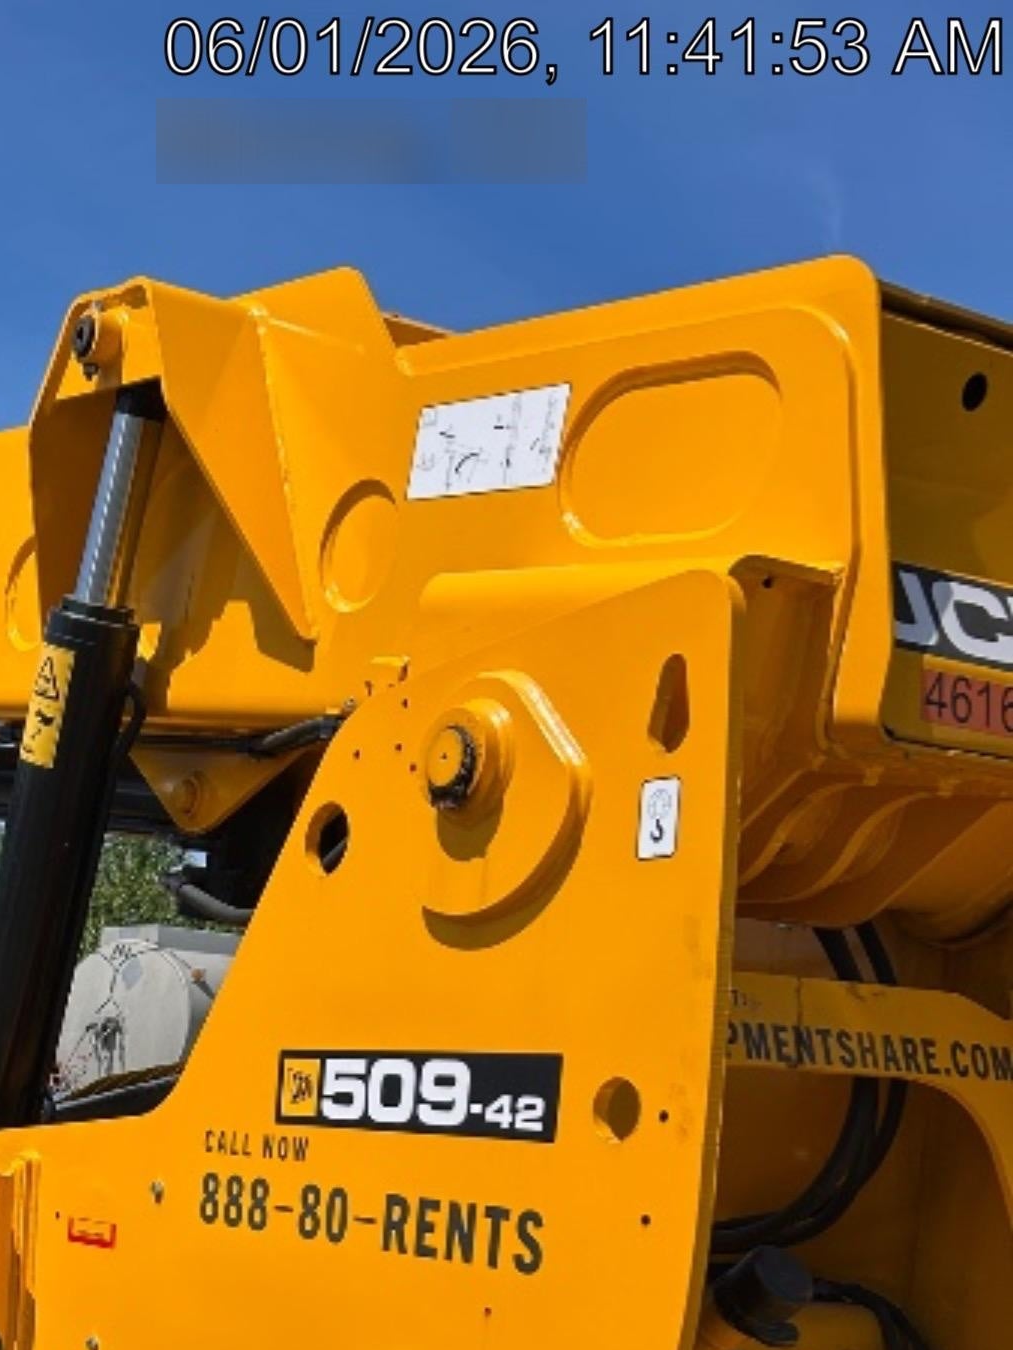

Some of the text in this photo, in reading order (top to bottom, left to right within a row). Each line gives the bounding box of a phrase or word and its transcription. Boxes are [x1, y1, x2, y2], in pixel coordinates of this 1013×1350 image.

[894, 570, 1013, 666] JC
[320, 1058, 546, 1132] 509-42
[204, 1128, 310, 1161] CALL NOW
[199, 1171, 545, 1276] 888-80-RENTS
